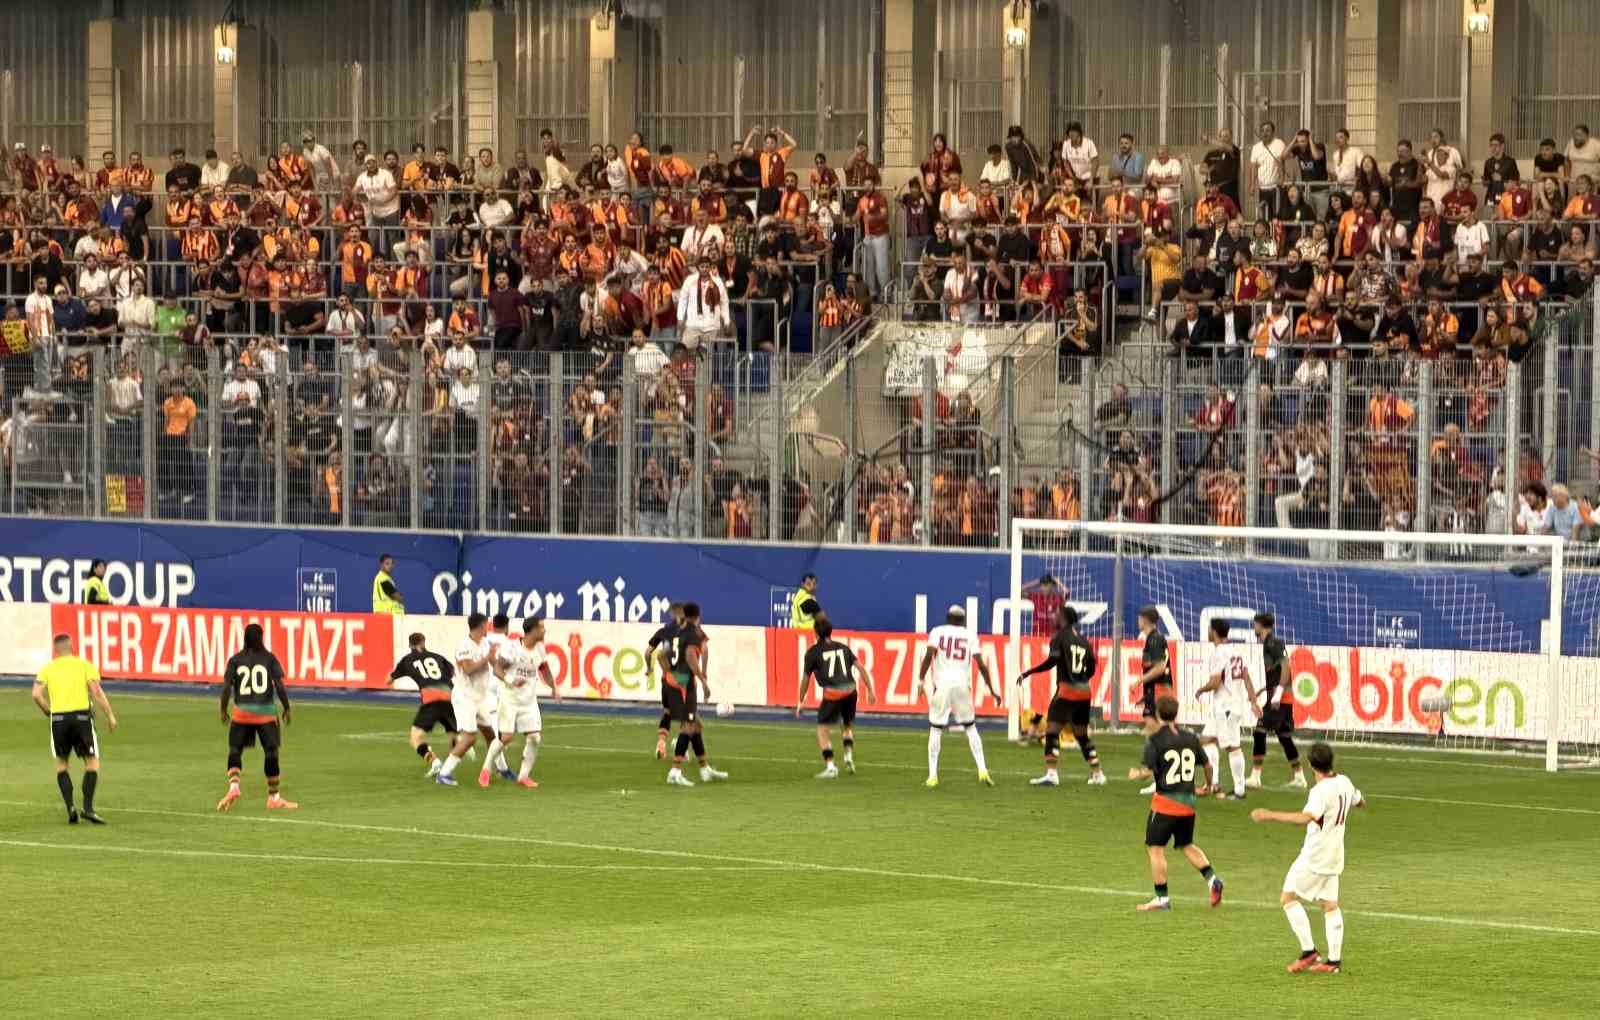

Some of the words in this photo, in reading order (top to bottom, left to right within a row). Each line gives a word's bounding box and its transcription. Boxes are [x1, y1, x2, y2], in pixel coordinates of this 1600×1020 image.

[77, 610, 143, 672] HER
[280, 619, 366, 681] TAZE
[938, 635, 969, 661] 45
[412, 656, 443, 681] 18
[822, 648, 848, 679] 71
[236, 664, 268, 696] 20
[1164, 748, 1196, 785] 28
[1335, 792, 1348, 827] 11
